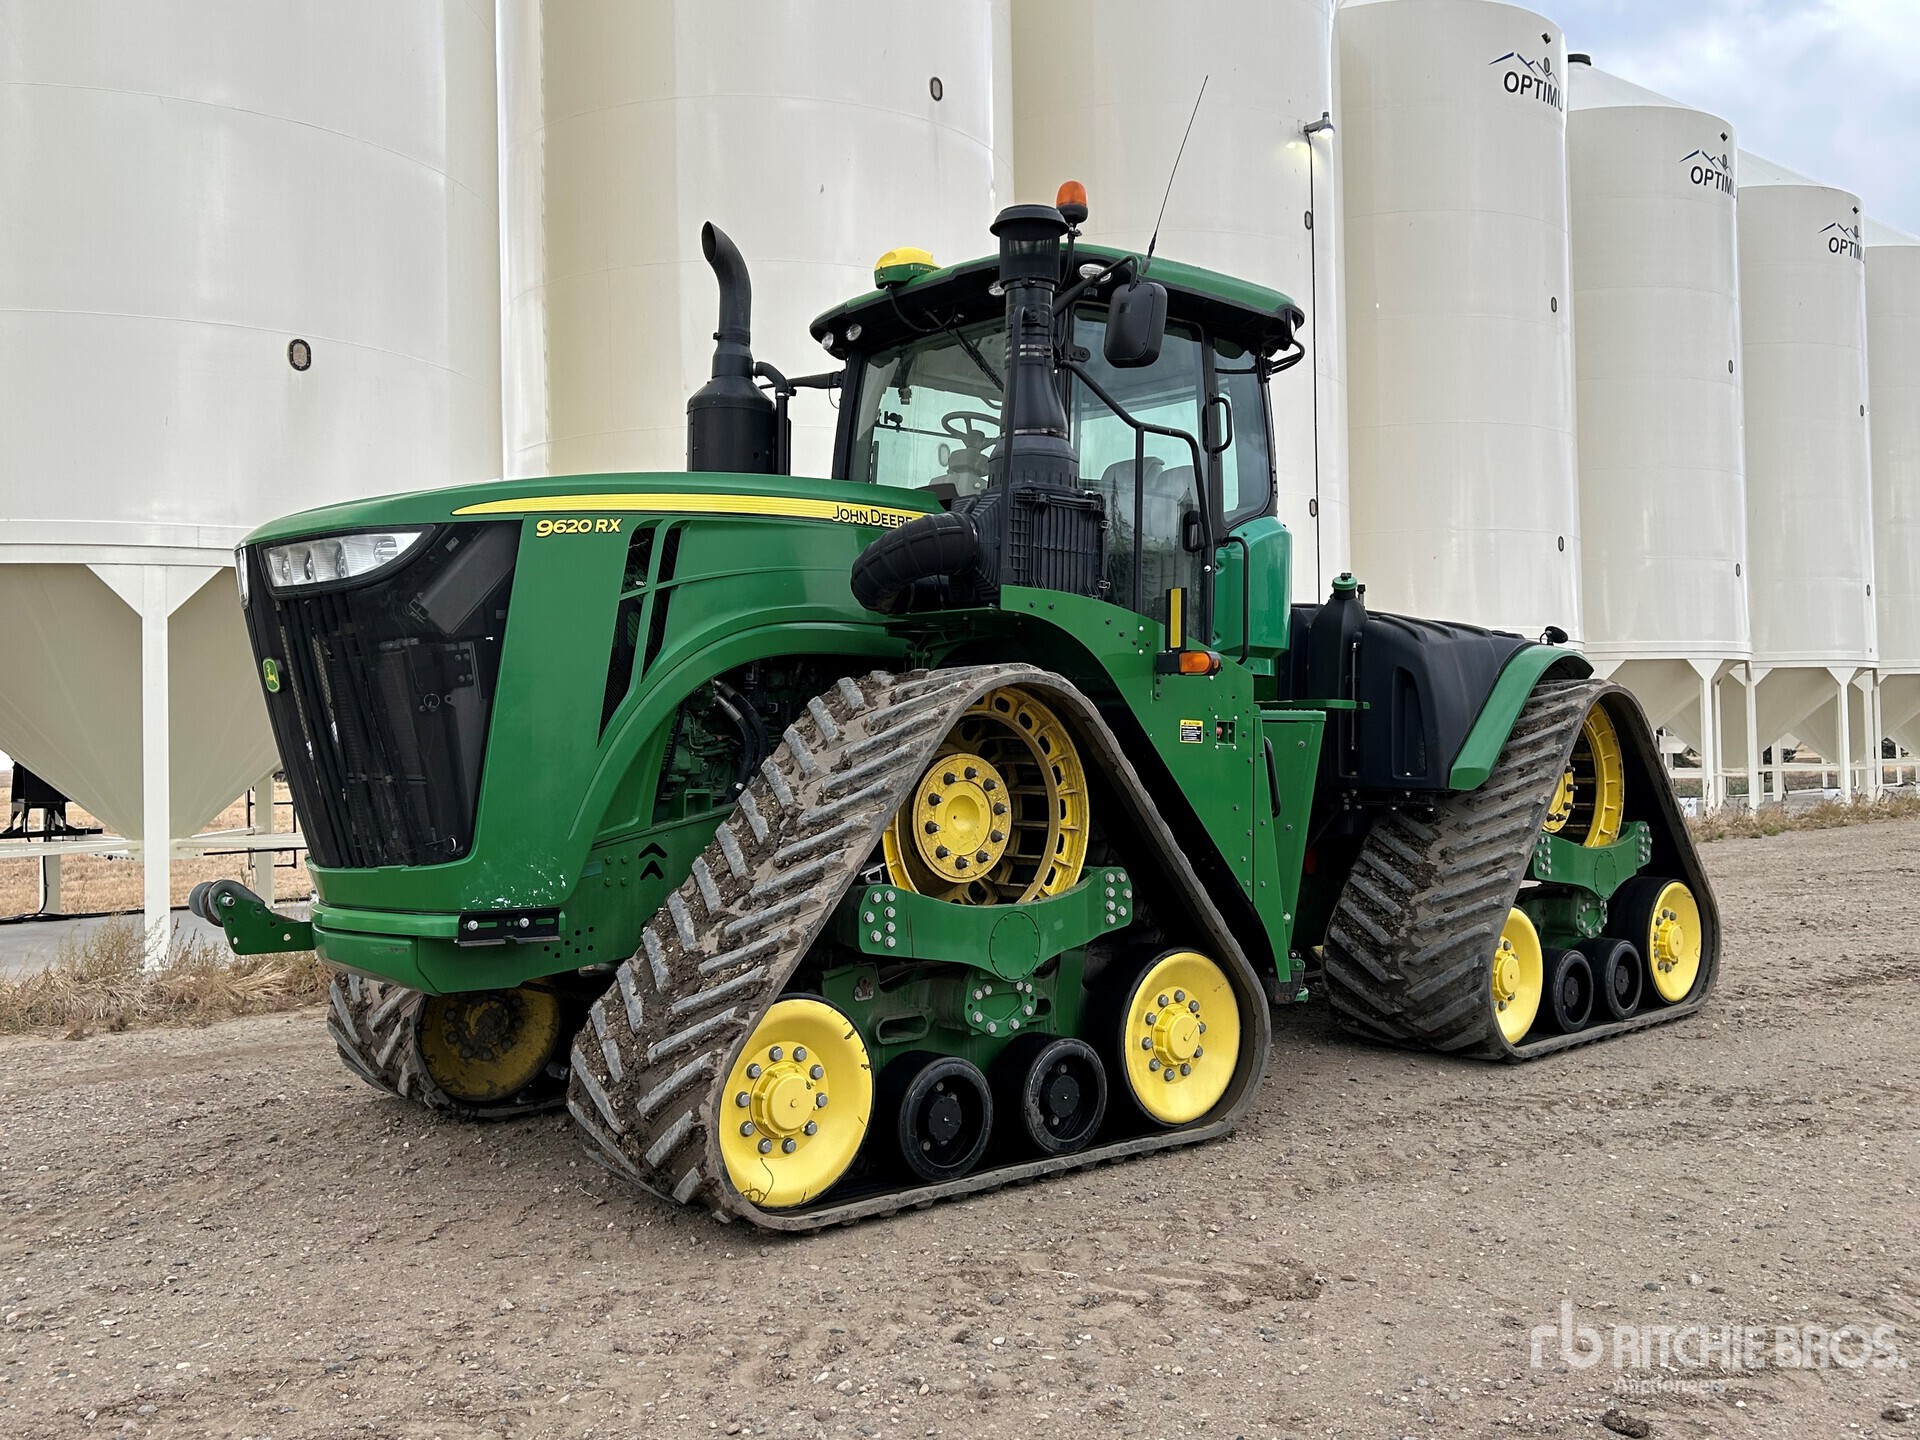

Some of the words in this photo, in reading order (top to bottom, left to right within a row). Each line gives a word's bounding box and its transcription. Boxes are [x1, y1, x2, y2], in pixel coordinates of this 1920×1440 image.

[832, 505, 869, 524] JOHN
[535, 518, 593, 538] 9620
[594, 517, 623, 533] RX
